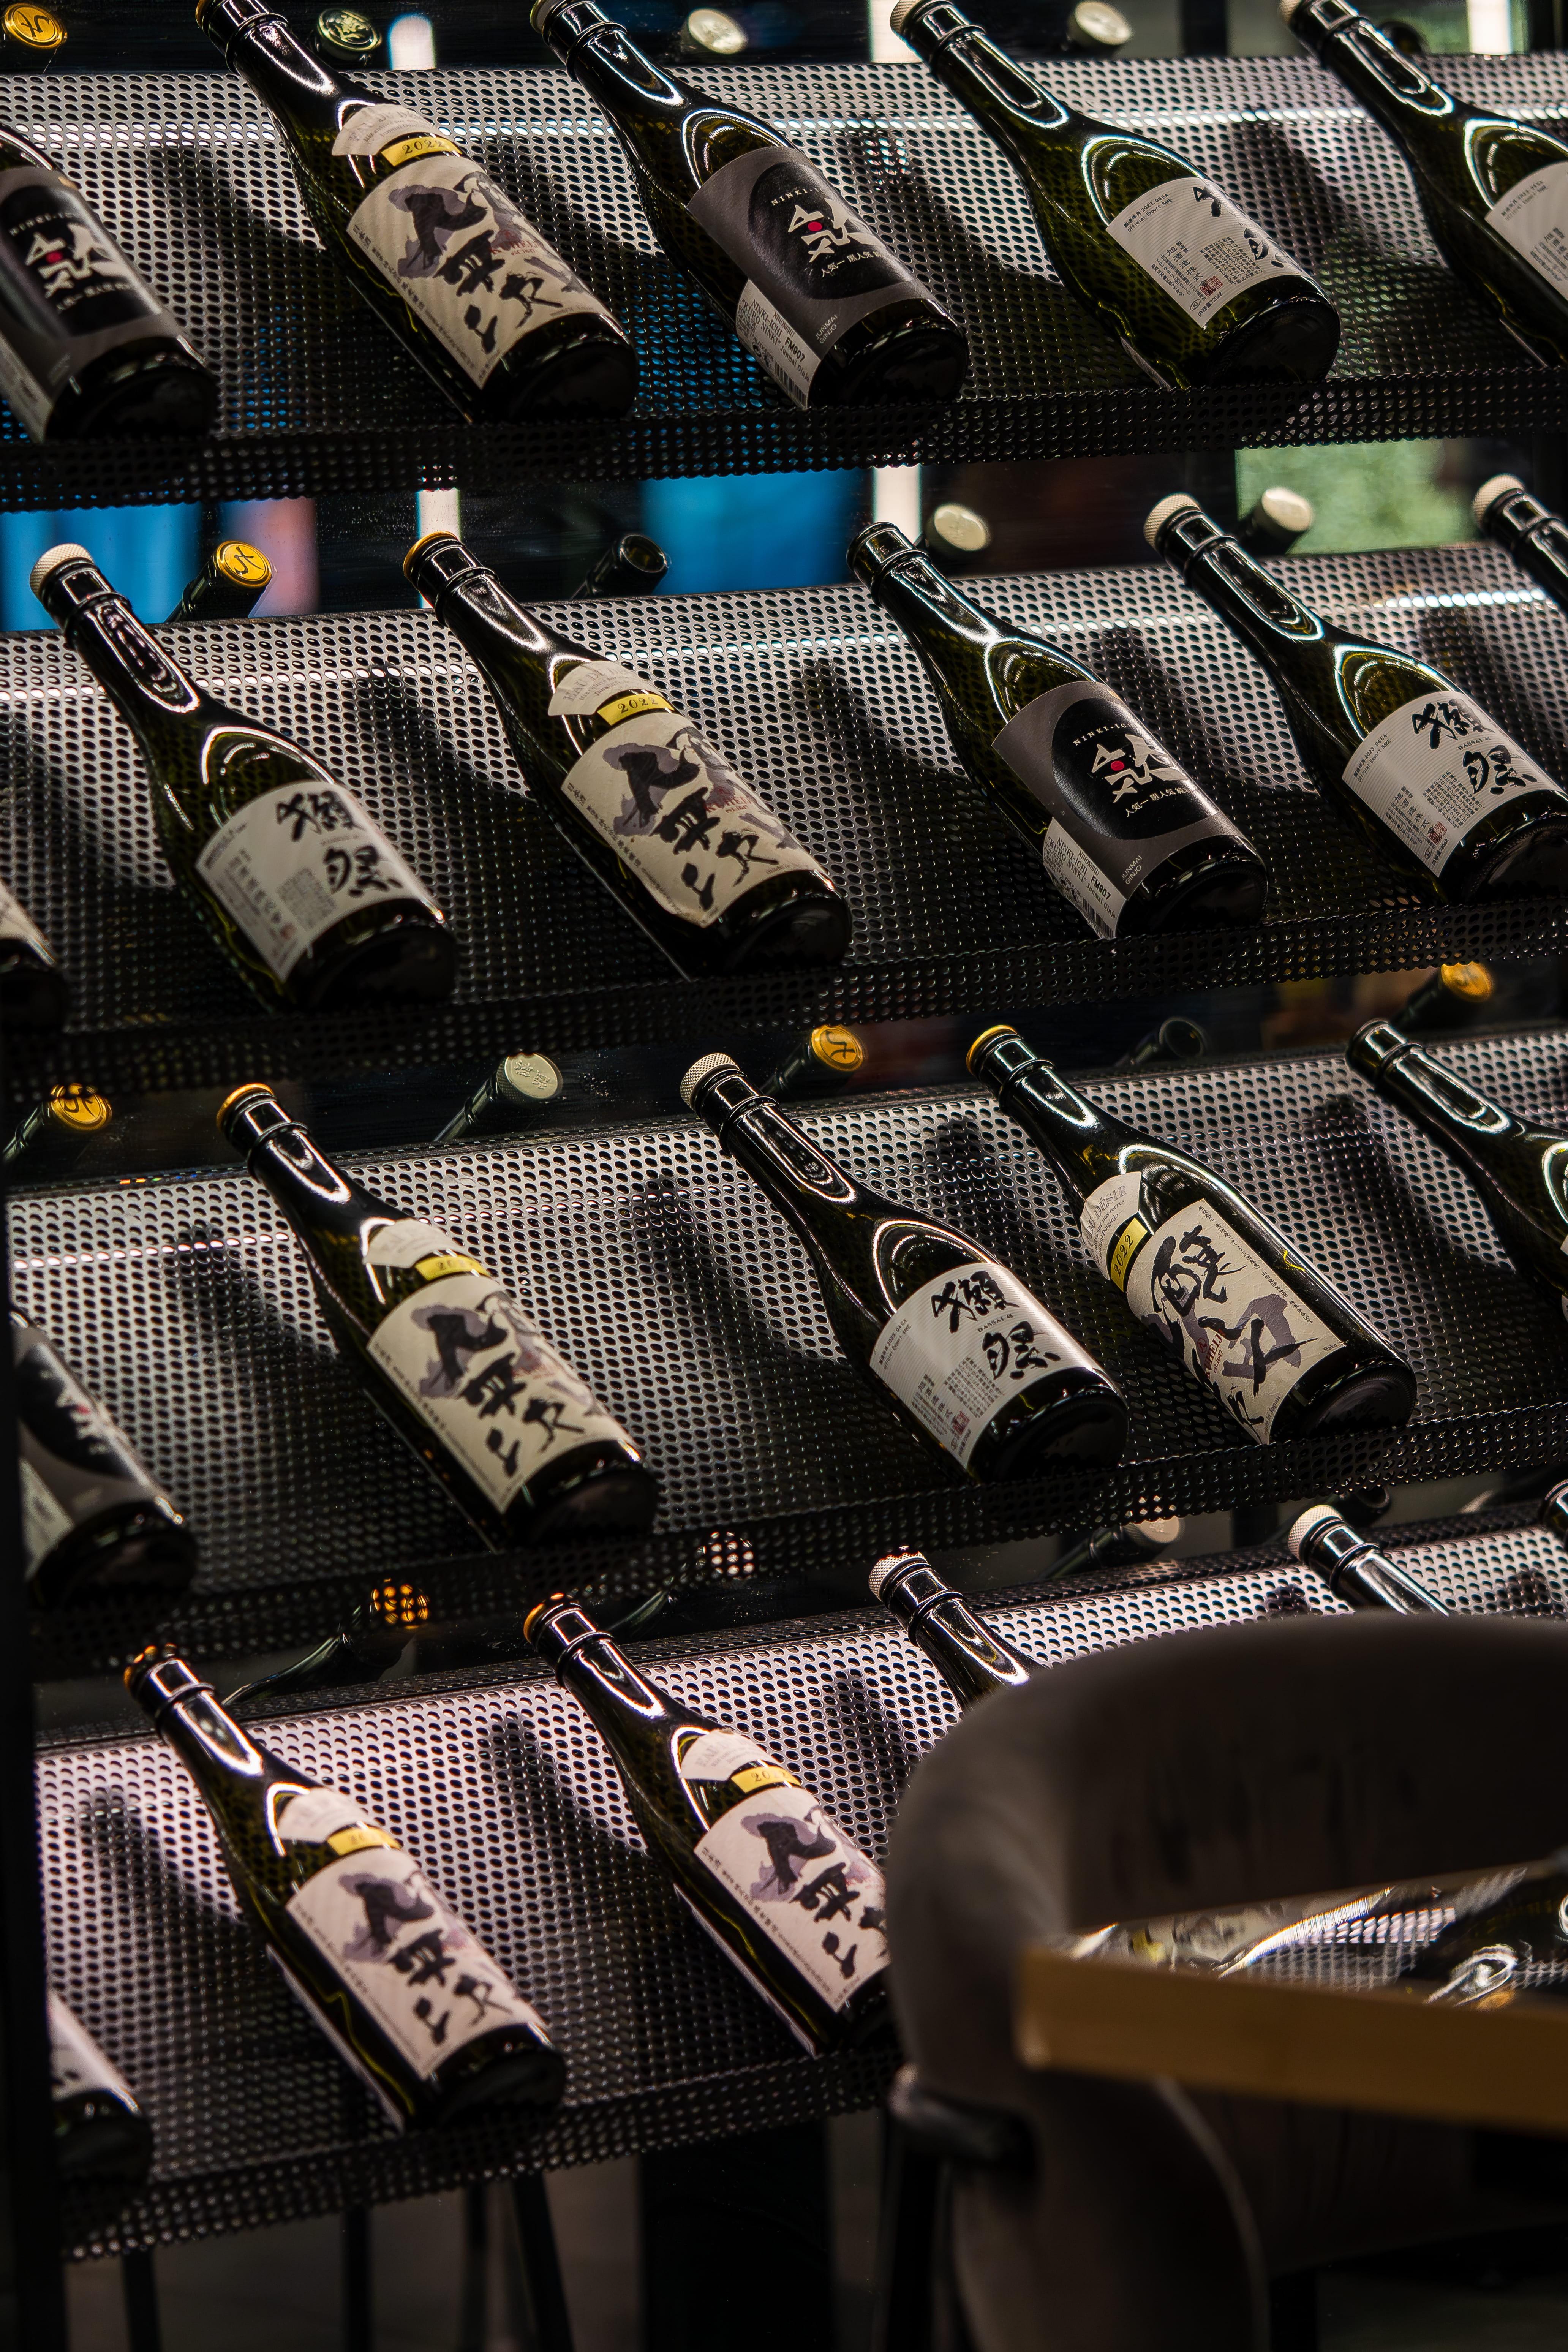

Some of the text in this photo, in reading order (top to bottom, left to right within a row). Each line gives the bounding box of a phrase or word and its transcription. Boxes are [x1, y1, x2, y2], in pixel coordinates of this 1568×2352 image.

[1127, 215, 1146, 232] Official
[1146, 205, 1161, 216] Export
[750, 299, 784, 337] NINKI-ICHI
[784, 337, 806, 362] FM907
[816, 314, 838, 340] JUNMAI
[819, 324, 837, 345] GINJO
[617, 695, 659, 714] 2022
[1369, 749, 1382, 763] Export
[1381, 739, 1391, 749] SAKE
[1457, 738, 1483, 750] DASSAI
[1126, 799, 1148, 817] 人気一
[1149, 788, 1176, 802] 黒人気
[1056, 837, 1089, 876] NINKI-ICHI
[1089, 875, 1111, 900] FM907
[1120, 855, 1142, 880] JUNMAI
[1125, 865, 1142, 884] GINJO
[1094, 1185, 1127, 1219] DÉSIR
[1101, 1212, 1110, 1222] nos
[1108, 1200, 1125, 1213] terres
[1102, 1213, 1119, 1236] Daiginjo
[1115, 1234, 1133, 1276] 2022
[977, 1316, 1004, 1332] DASSAI
[1323, 1344, 1337, 1352] Sake
[1214, 1349, 1223, 1373] est.1647
